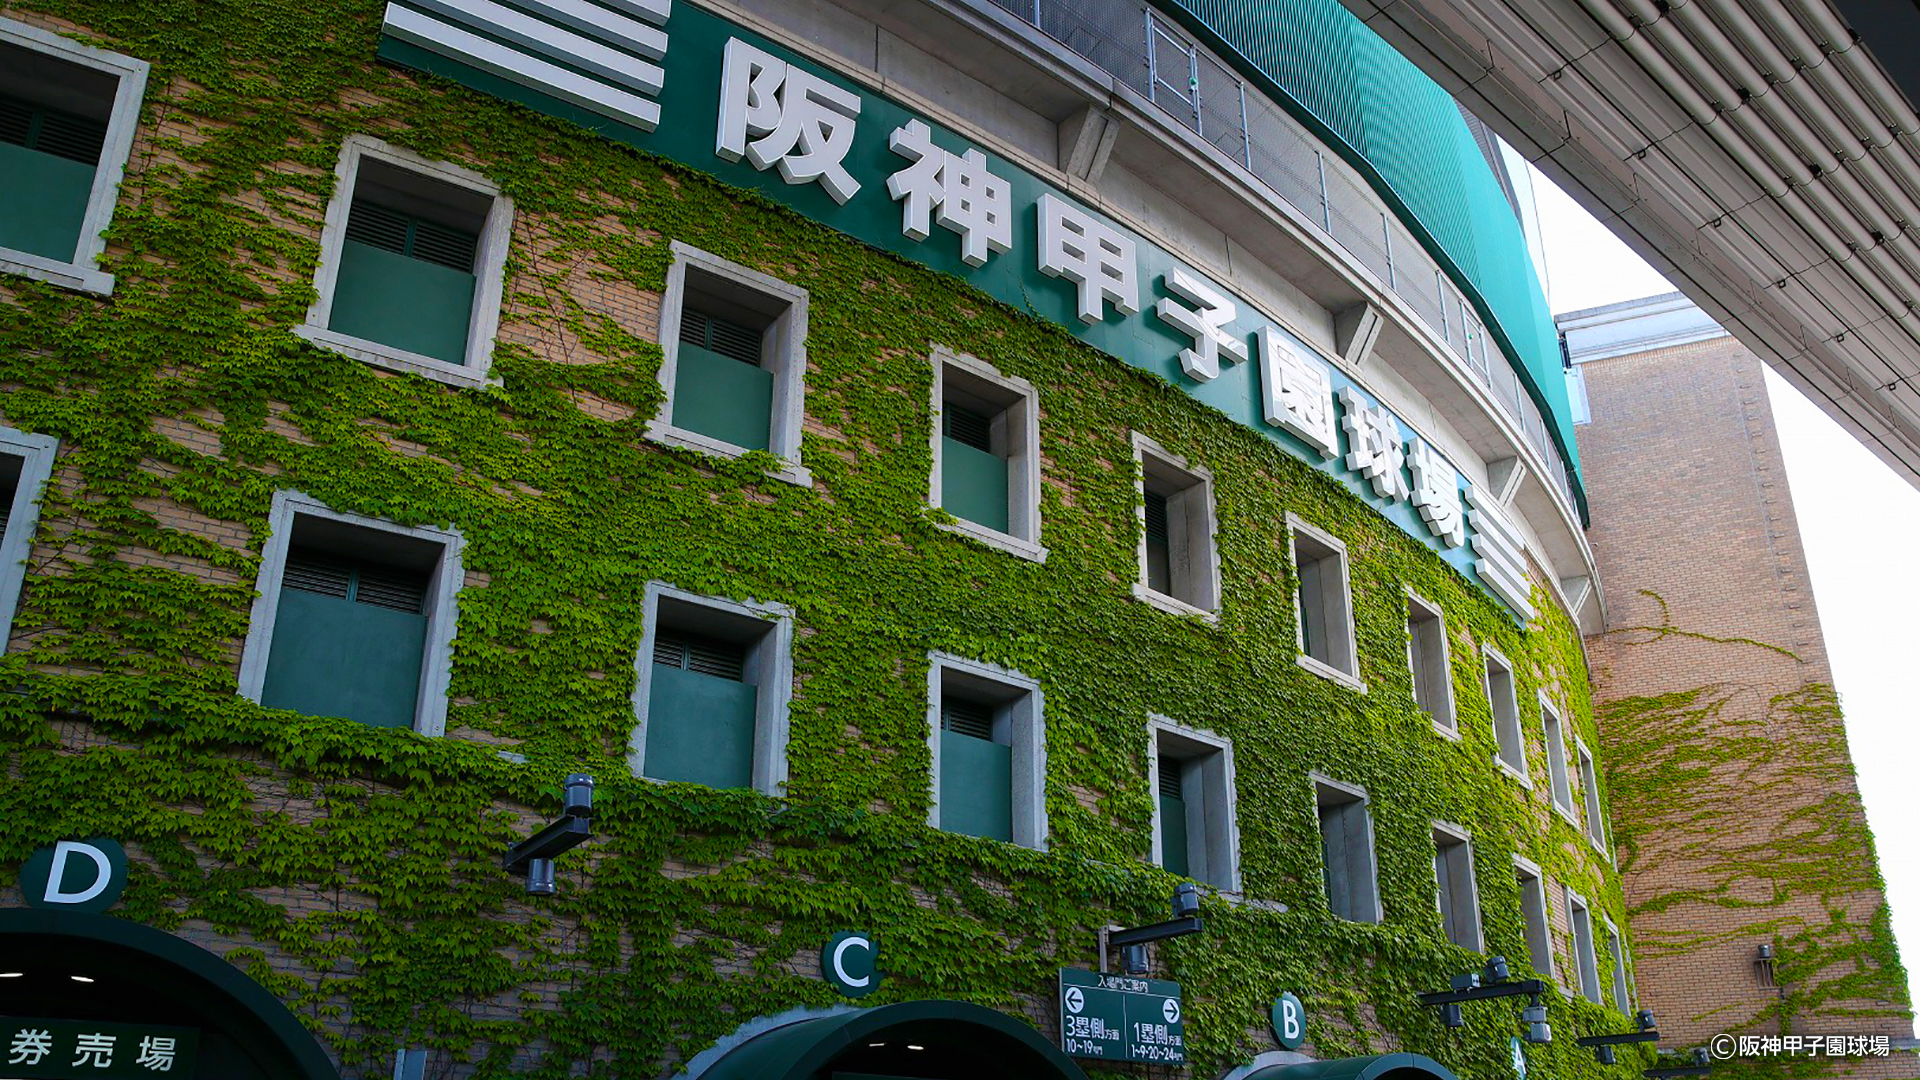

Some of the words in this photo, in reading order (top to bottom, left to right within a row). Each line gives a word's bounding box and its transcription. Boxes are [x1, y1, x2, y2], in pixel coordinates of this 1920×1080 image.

[716, 36, 1463, 549] 阪神甲子園球場
[43, 840, 112, 904] D
[833, 936, 870, 988] C
[1097, 975, 1149, 993] 入場門ご案内
[1282, 1000, 1300, 1039] B
[8, 1028, 177, 1071] 券売場
[1513, 1040, 1527, 1075] A
